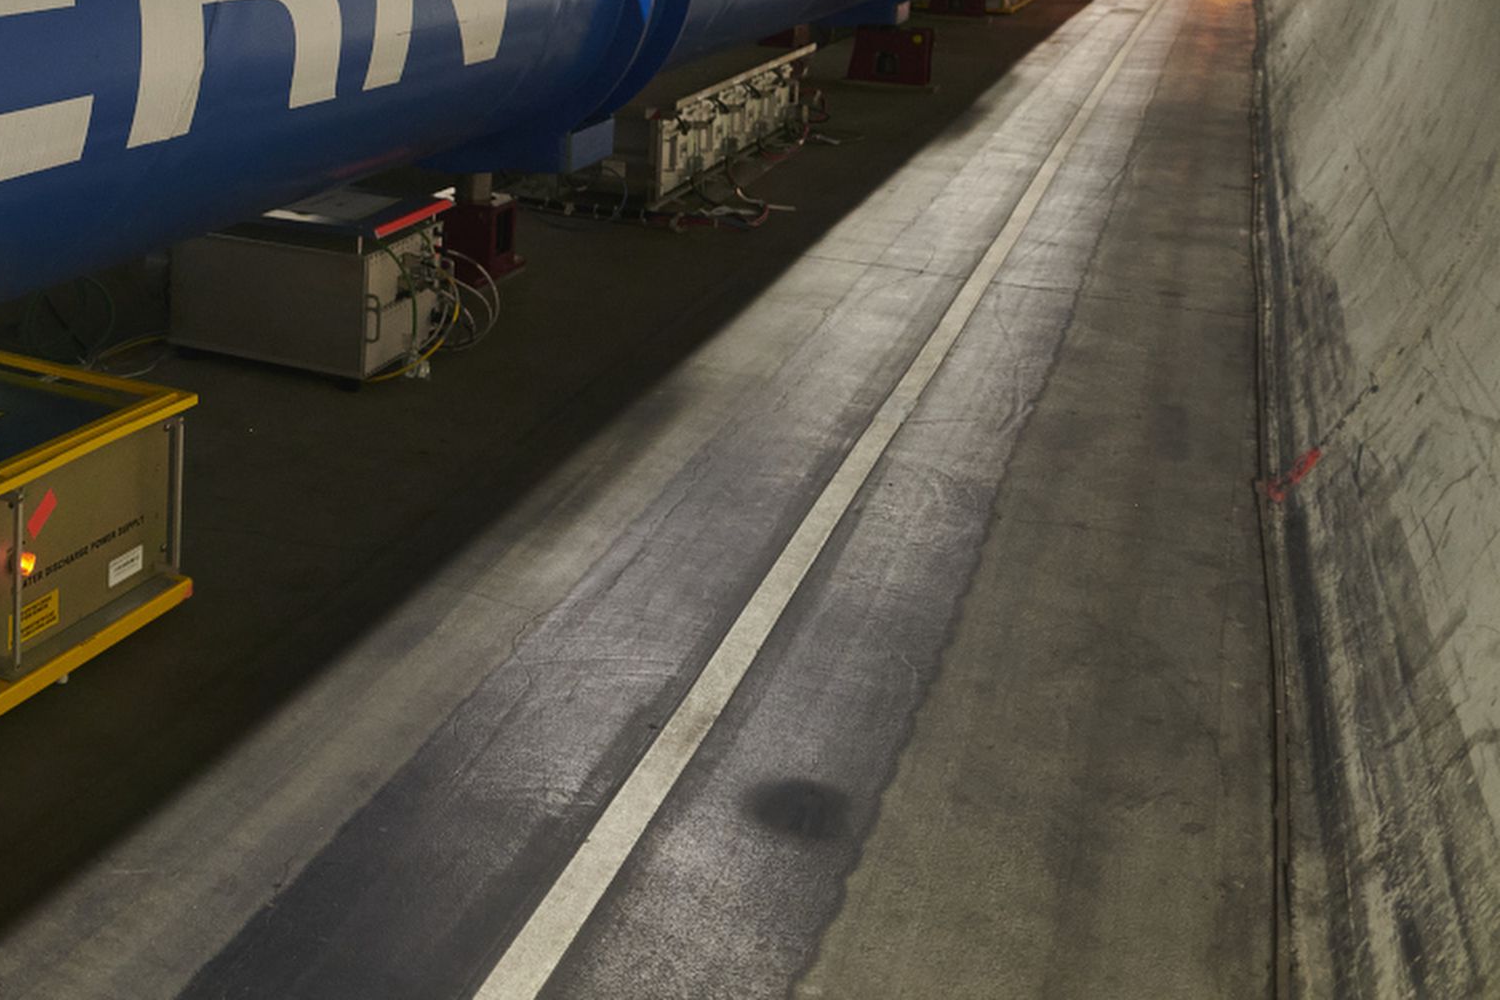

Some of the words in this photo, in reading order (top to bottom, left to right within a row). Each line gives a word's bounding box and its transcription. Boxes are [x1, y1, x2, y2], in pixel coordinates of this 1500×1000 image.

[45, 545, 89, 577] DISCHARGE
[91, 530, 117, 550] POWER
[118, 515, 145, 537] SUPPLY
